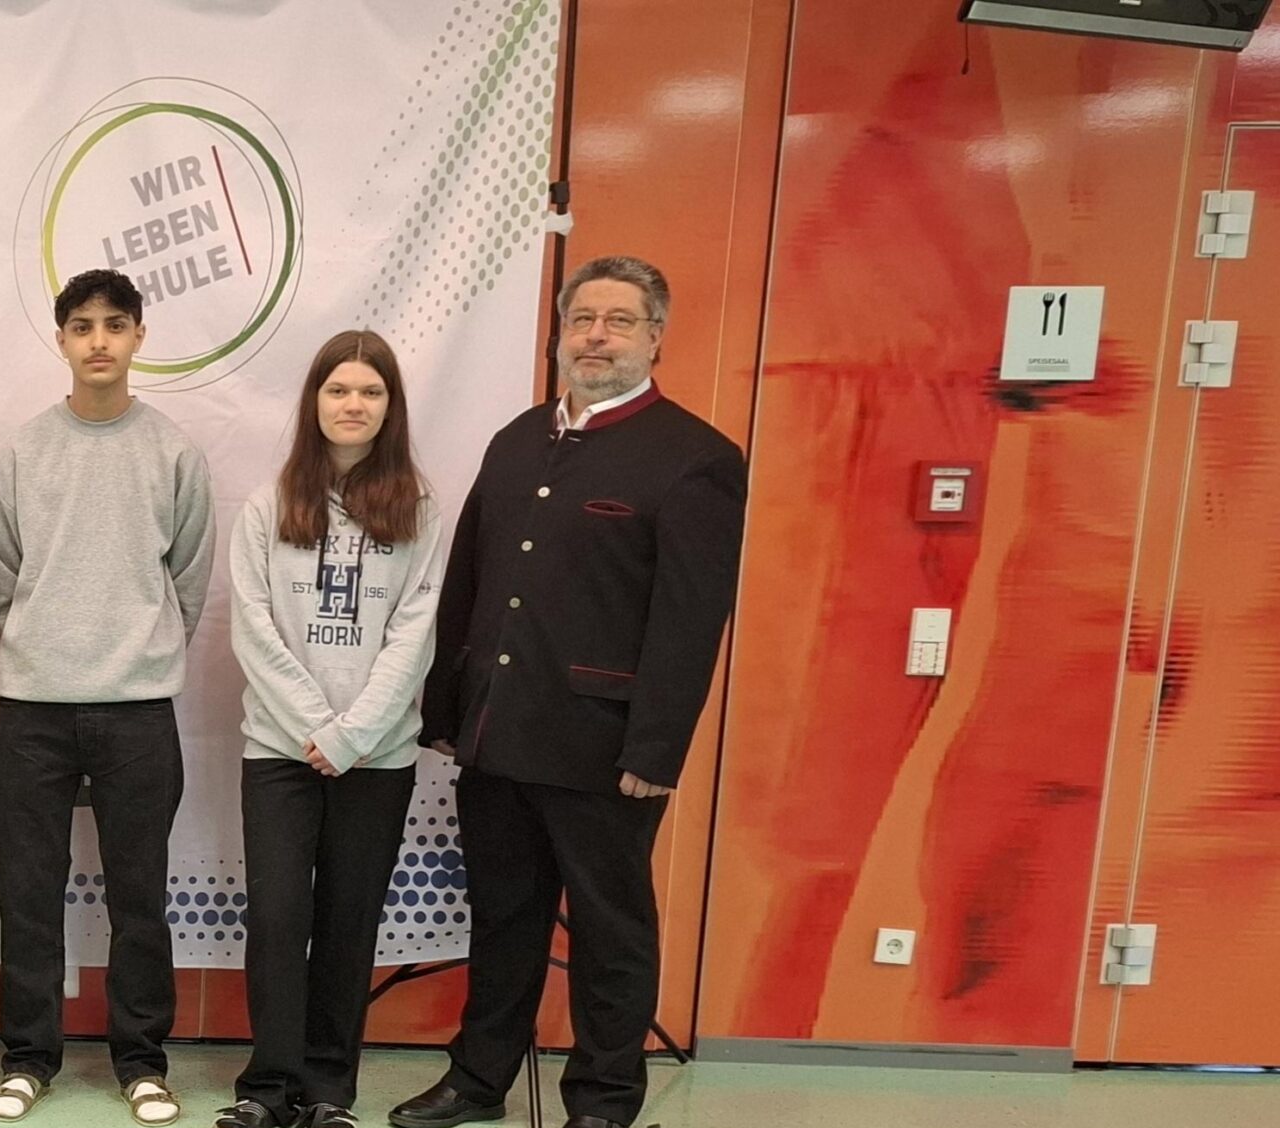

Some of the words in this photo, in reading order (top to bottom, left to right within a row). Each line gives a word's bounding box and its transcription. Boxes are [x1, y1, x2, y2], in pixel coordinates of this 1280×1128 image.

[130, 155, 207, 207] WIR
[102, 200, 220, 270] LEBEN
[136, 245, 233, 307] HULE
[292, 582, 314, 595] EST.
[306, 623, 363, 647] HORN
